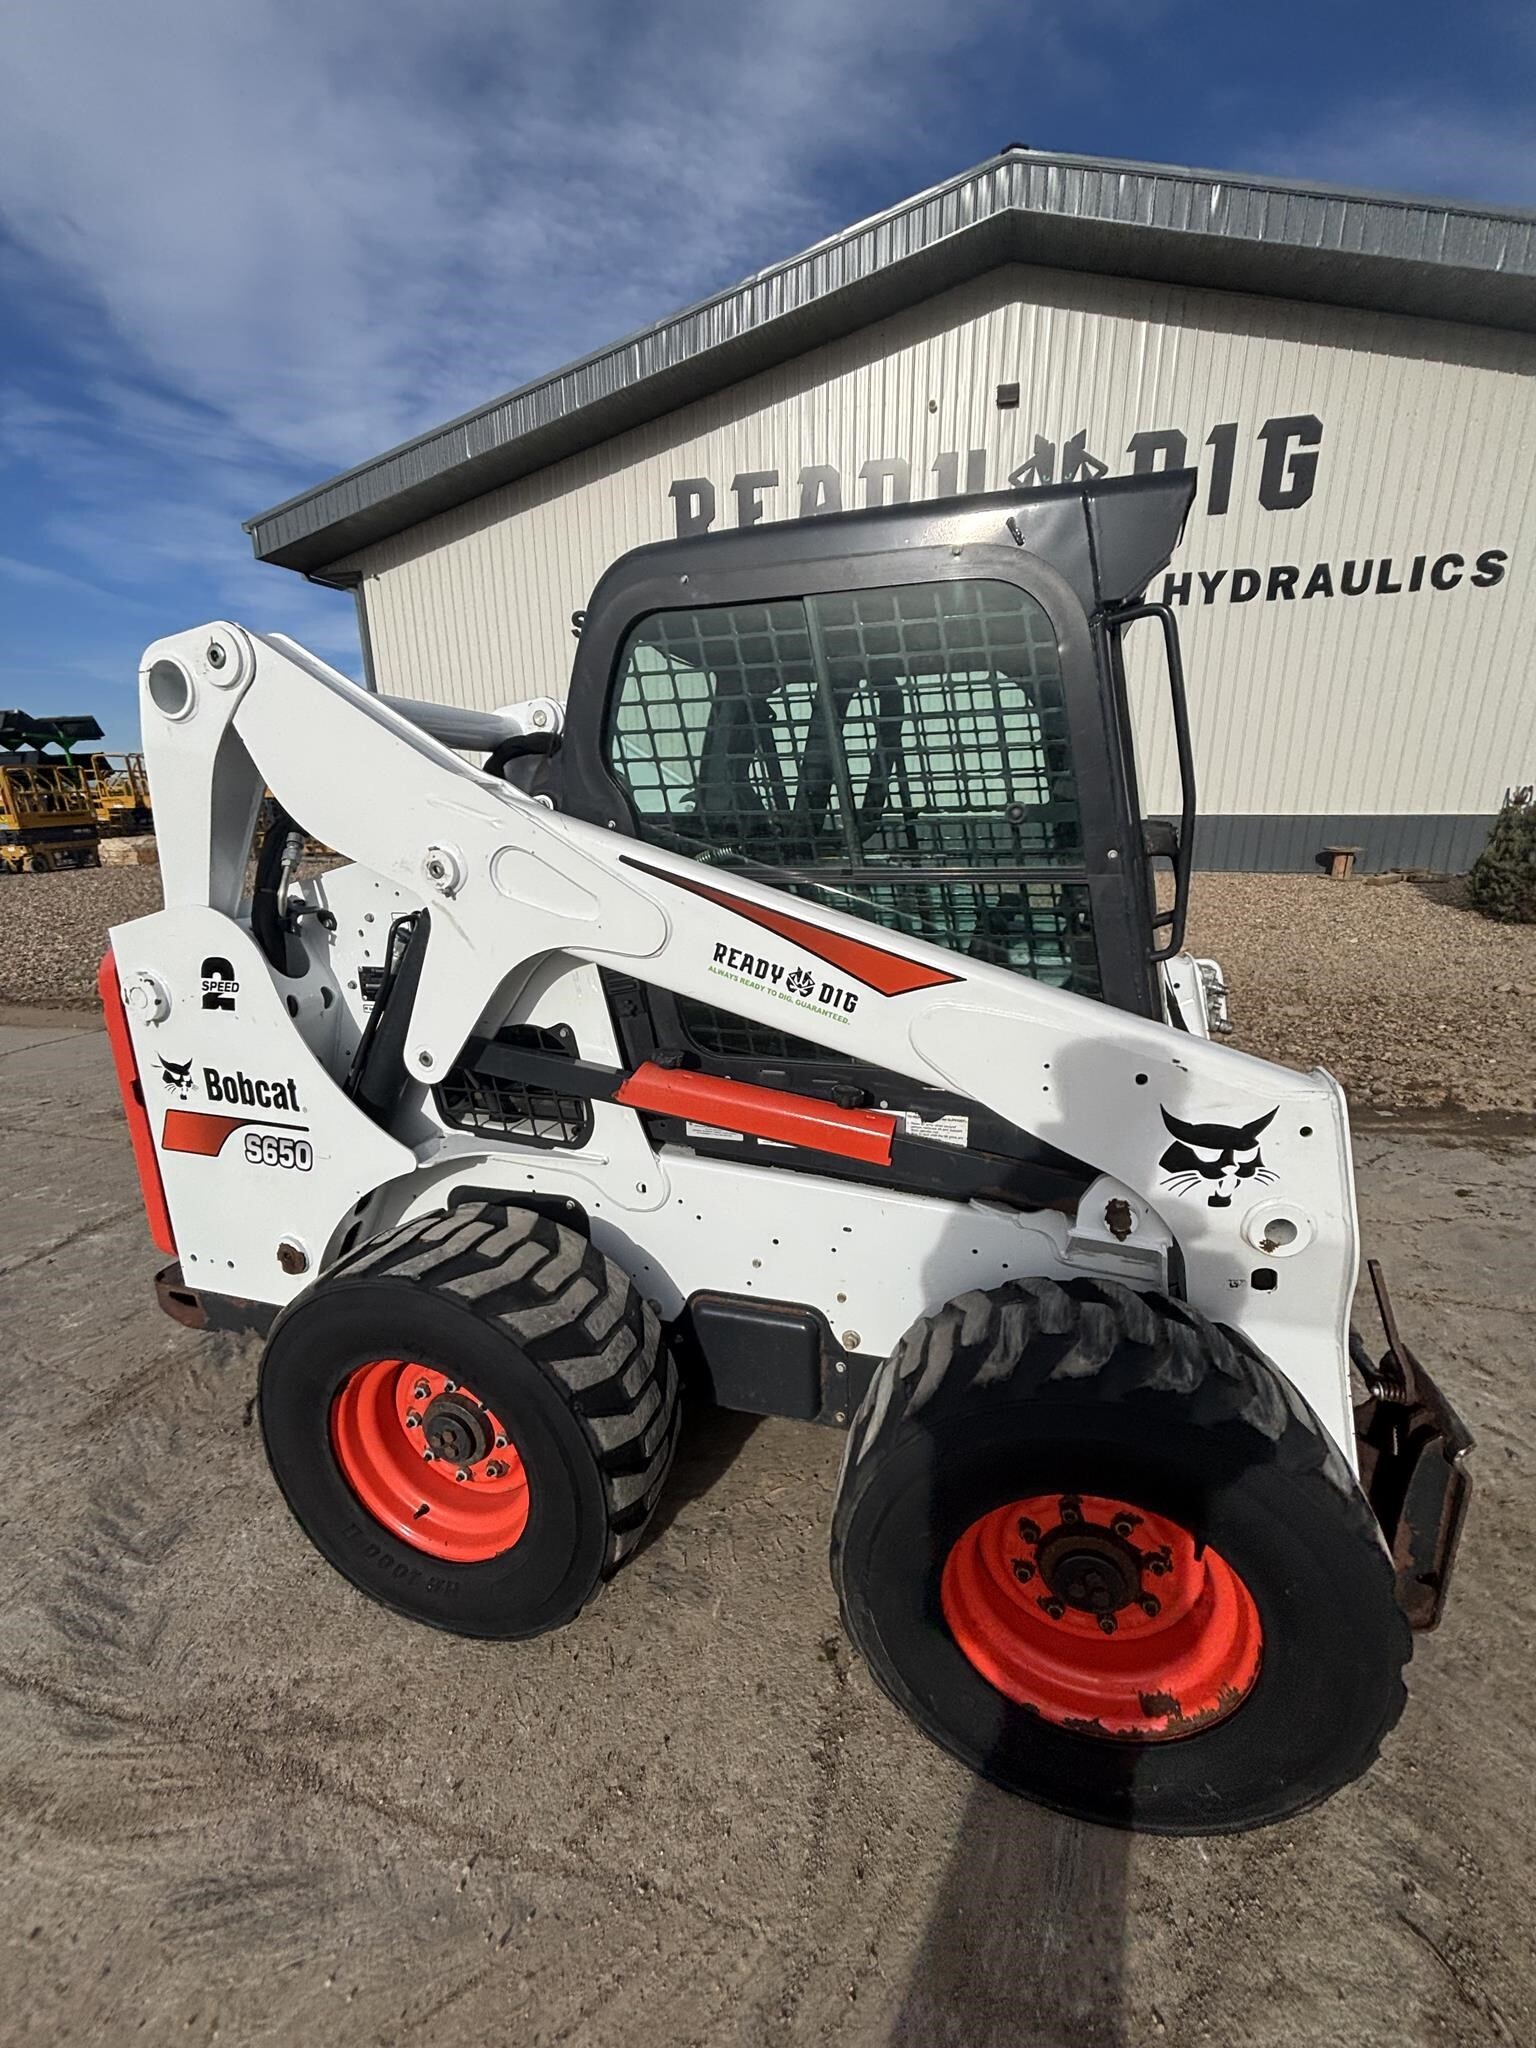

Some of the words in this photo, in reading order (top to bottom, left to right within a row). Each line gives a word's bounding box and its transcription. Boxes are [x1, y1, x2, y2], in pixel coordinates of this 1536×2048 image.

[1162, 550, 1509, 606] HYDRAULICS
[201, 980, 240, 993] SPEED
[708, 965, 739, 982] ALWAYS
[740, 977, 766, 991] READY
[767, 988, 778, 997] TO
[713, 942, 785, 984] READY
[818, 982, 859, 1014] DIG
[203, 1067, 300, 1112] Bobcat
[245, 1133, 313, 1172] S650
